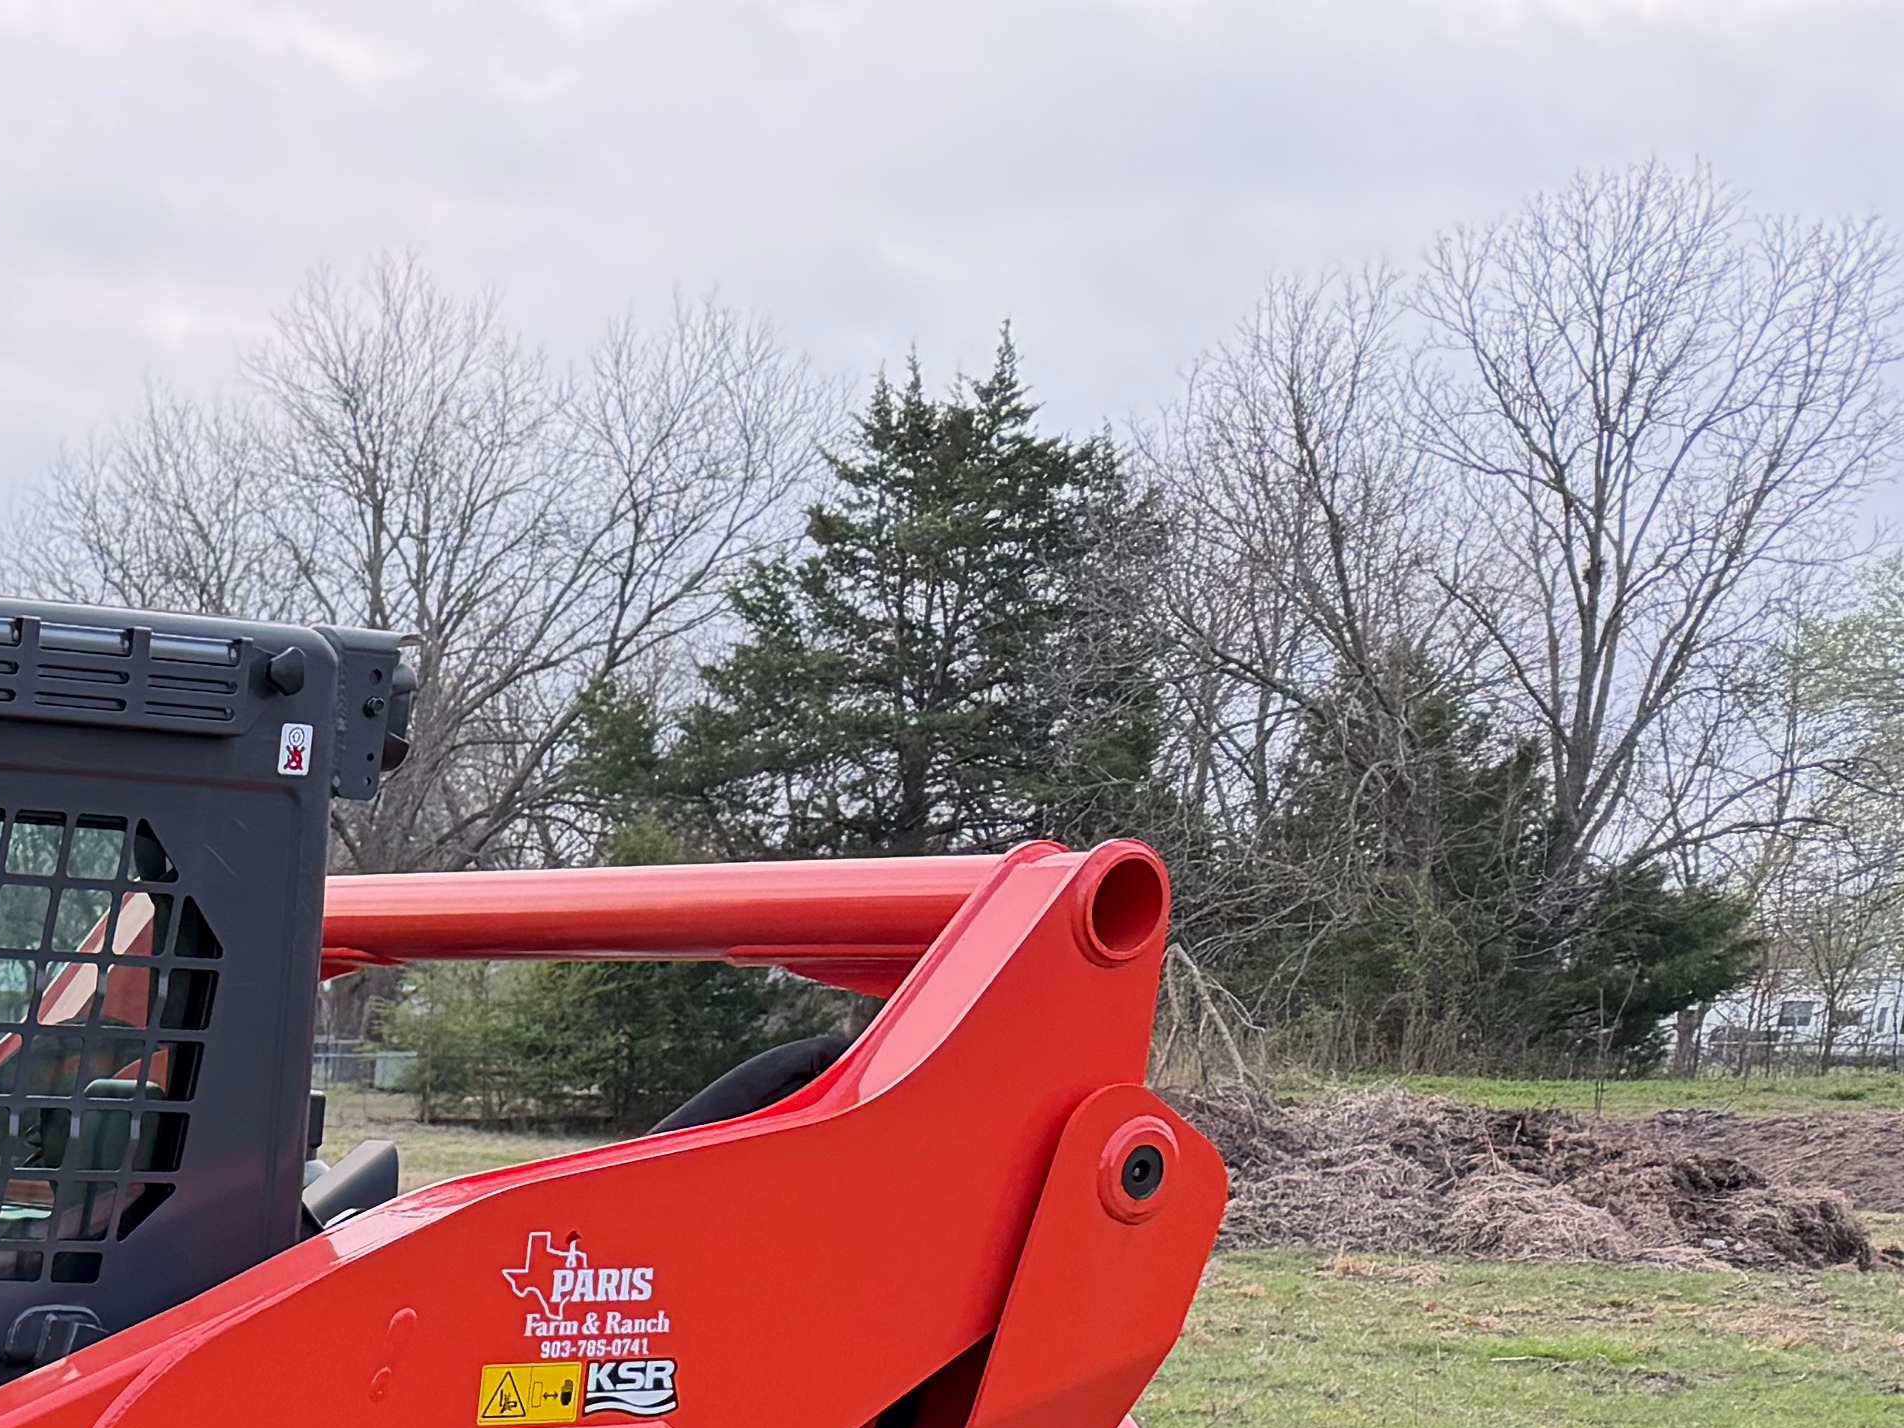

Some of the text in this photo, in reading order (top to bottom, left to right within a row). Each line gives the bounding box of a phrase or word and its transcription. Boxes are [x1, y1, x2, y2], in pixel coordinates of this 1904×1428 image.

[550, 1267, 654, 1303] PARIS
[524, 1310, 670, 1337] Farm & Ranch
[541, 1338, 649, 1358] 903-785-0741
[587, 1360, 675, 1391] KSR
